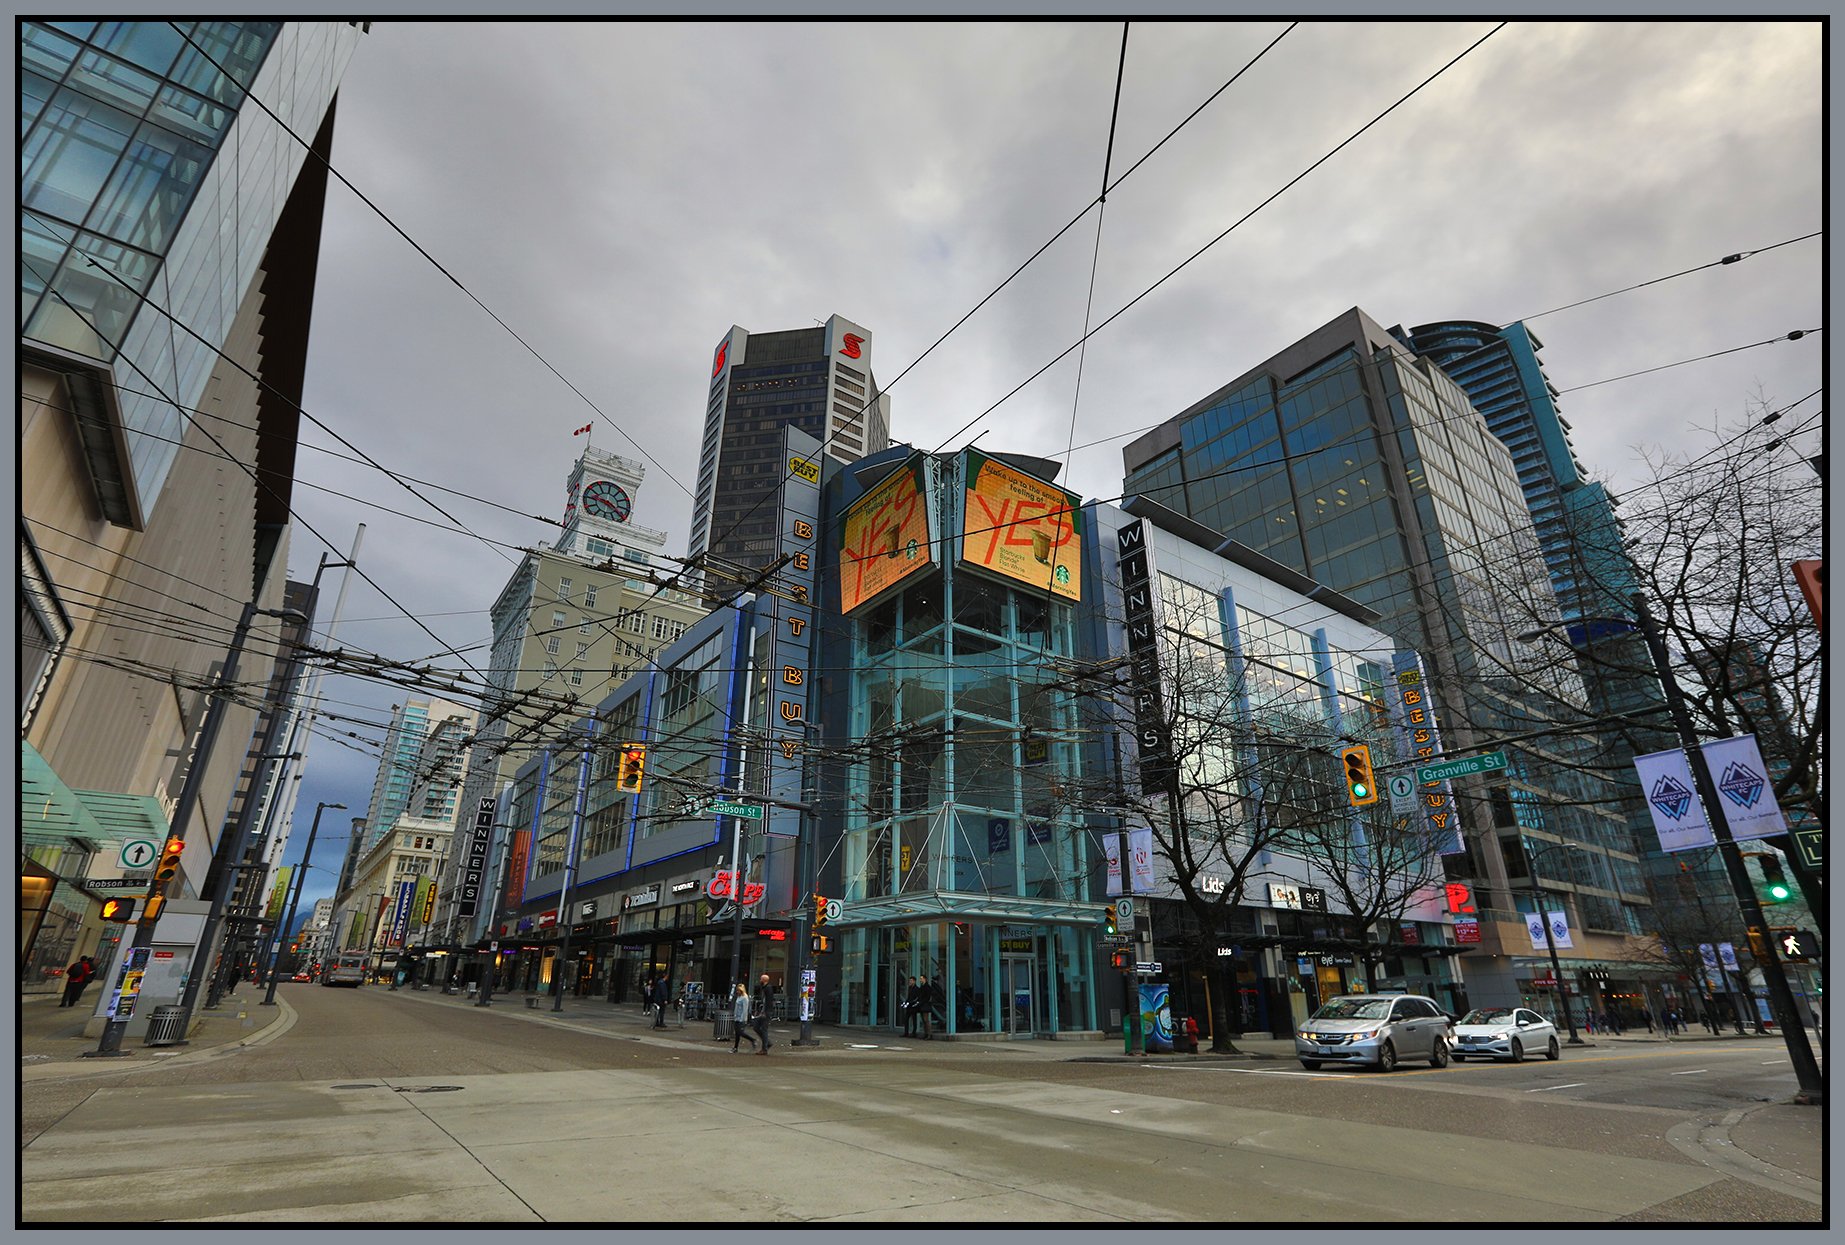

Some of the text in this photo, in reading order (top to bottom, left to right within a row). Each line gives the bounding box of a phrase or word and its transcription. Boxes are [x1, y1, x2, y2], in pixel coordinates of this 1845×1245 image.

[793, 459, 818, 475] BEST
[985, 464, 1007, 480] Wake
[1008, 477, 1018, 485] up
[1020, 480, 1028, 489] to
[1029, 485, 1040, 495] the
[1010, 484, 1035, 502] feeling
[845, 469, 917, 605] YES
[976, 494, 1075, 565] YES
[788, 519, 813, 637] BEST
[1120, 526, 1159, 749] WINNERS
[780, 665, 803, 758] BUY
[1404, 690, 1432, 762] BEST
[1422, 755, 1500, 781] Granville St
[1721, 780, 1762, 790] WHITECAPS
[1652, 793, 1690, 803] WHITECAPS
[714, 802, 756, 817] Robson St
[465, 800, 495, 898] WINNERS
[709, 879, 765, 898] CRPE
[1202, 876, 1225, 894] Lids
[1013, 941, 1031, 949] BUY
[1217, 948, 1232, 956] Lids
